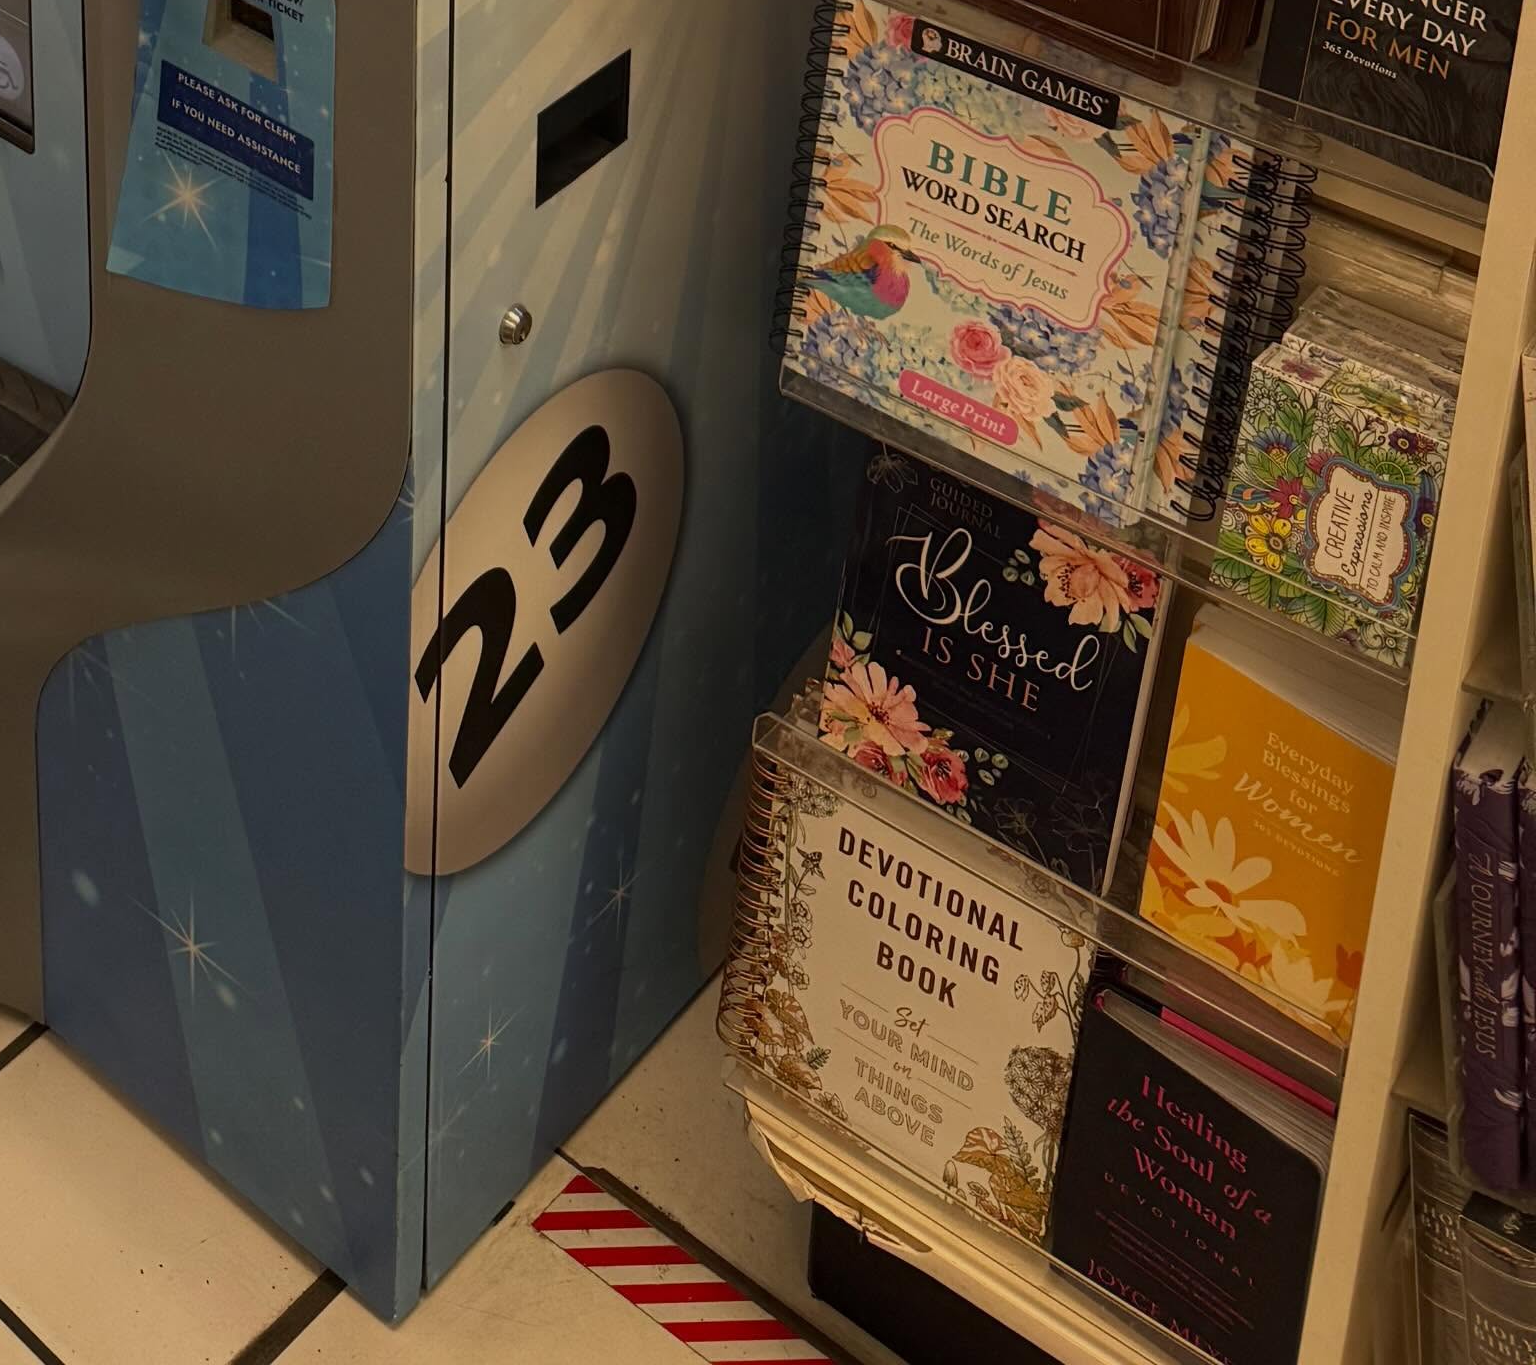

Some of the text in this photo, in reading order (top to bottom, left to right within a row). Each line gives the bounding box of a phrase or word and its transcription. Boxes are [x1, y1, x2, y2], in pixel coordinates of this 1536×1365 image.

[946, 39, 1017, 83] BRAIN
[1323, 40, 1398, 80] 365 Devotions
[1326, 11, 1450, 80] FOR MEN
[1422, 20, 1477, 58] DAY
[171, 96, 302, 175] IF YOU NEED ASSISTANCE
[178, 73, 297, 146] PLEASE ASK FOR CLERK
[901, 166, 1087, 264] WORD SEARCH
[926, 139, 1074, 227] BIBLE
[908, 216, 1070, 301] The Words of Jesus
[911, 379, 1008, 438] Large Print
[930, 476, 994, 519] GUIDED
[930, 493, 1001, 540] JOURNAL
[414, 425, 636, 788] 23
[885, 528, 1100, 691] Blessed
[921, 627, 1040, 712] IS SHE
[1263, 750, 1352, 814] Blessings
[1267, 732, 1354, 796] Everyday
[1233, 772, 1364, 865] Women
[1289, 788, 1318, 816] for
[838, 826, 1024, 951] DEVOTIONAL
[847, 879, 1001, 985] COLORING
[876, 940, 957, 1008] BOOK
[839, 998, 975, 1093] YOUR MIND
[894, 1007, 930, 1039] Set
[854, 1056, 943, 1125] THINGS
[892, 1059, 913, 1080] on
[854, 1088, 936, 1148] ABOVE
[1141, 1075, 1249, 1173] Healing
[1107, 1097, 1146, 1132] the
[1153, 1126, 1214, 1185] Soul
[1223, 1181, 1257, 1211] of
[1133, 1146, 1238, 1241] Woman
